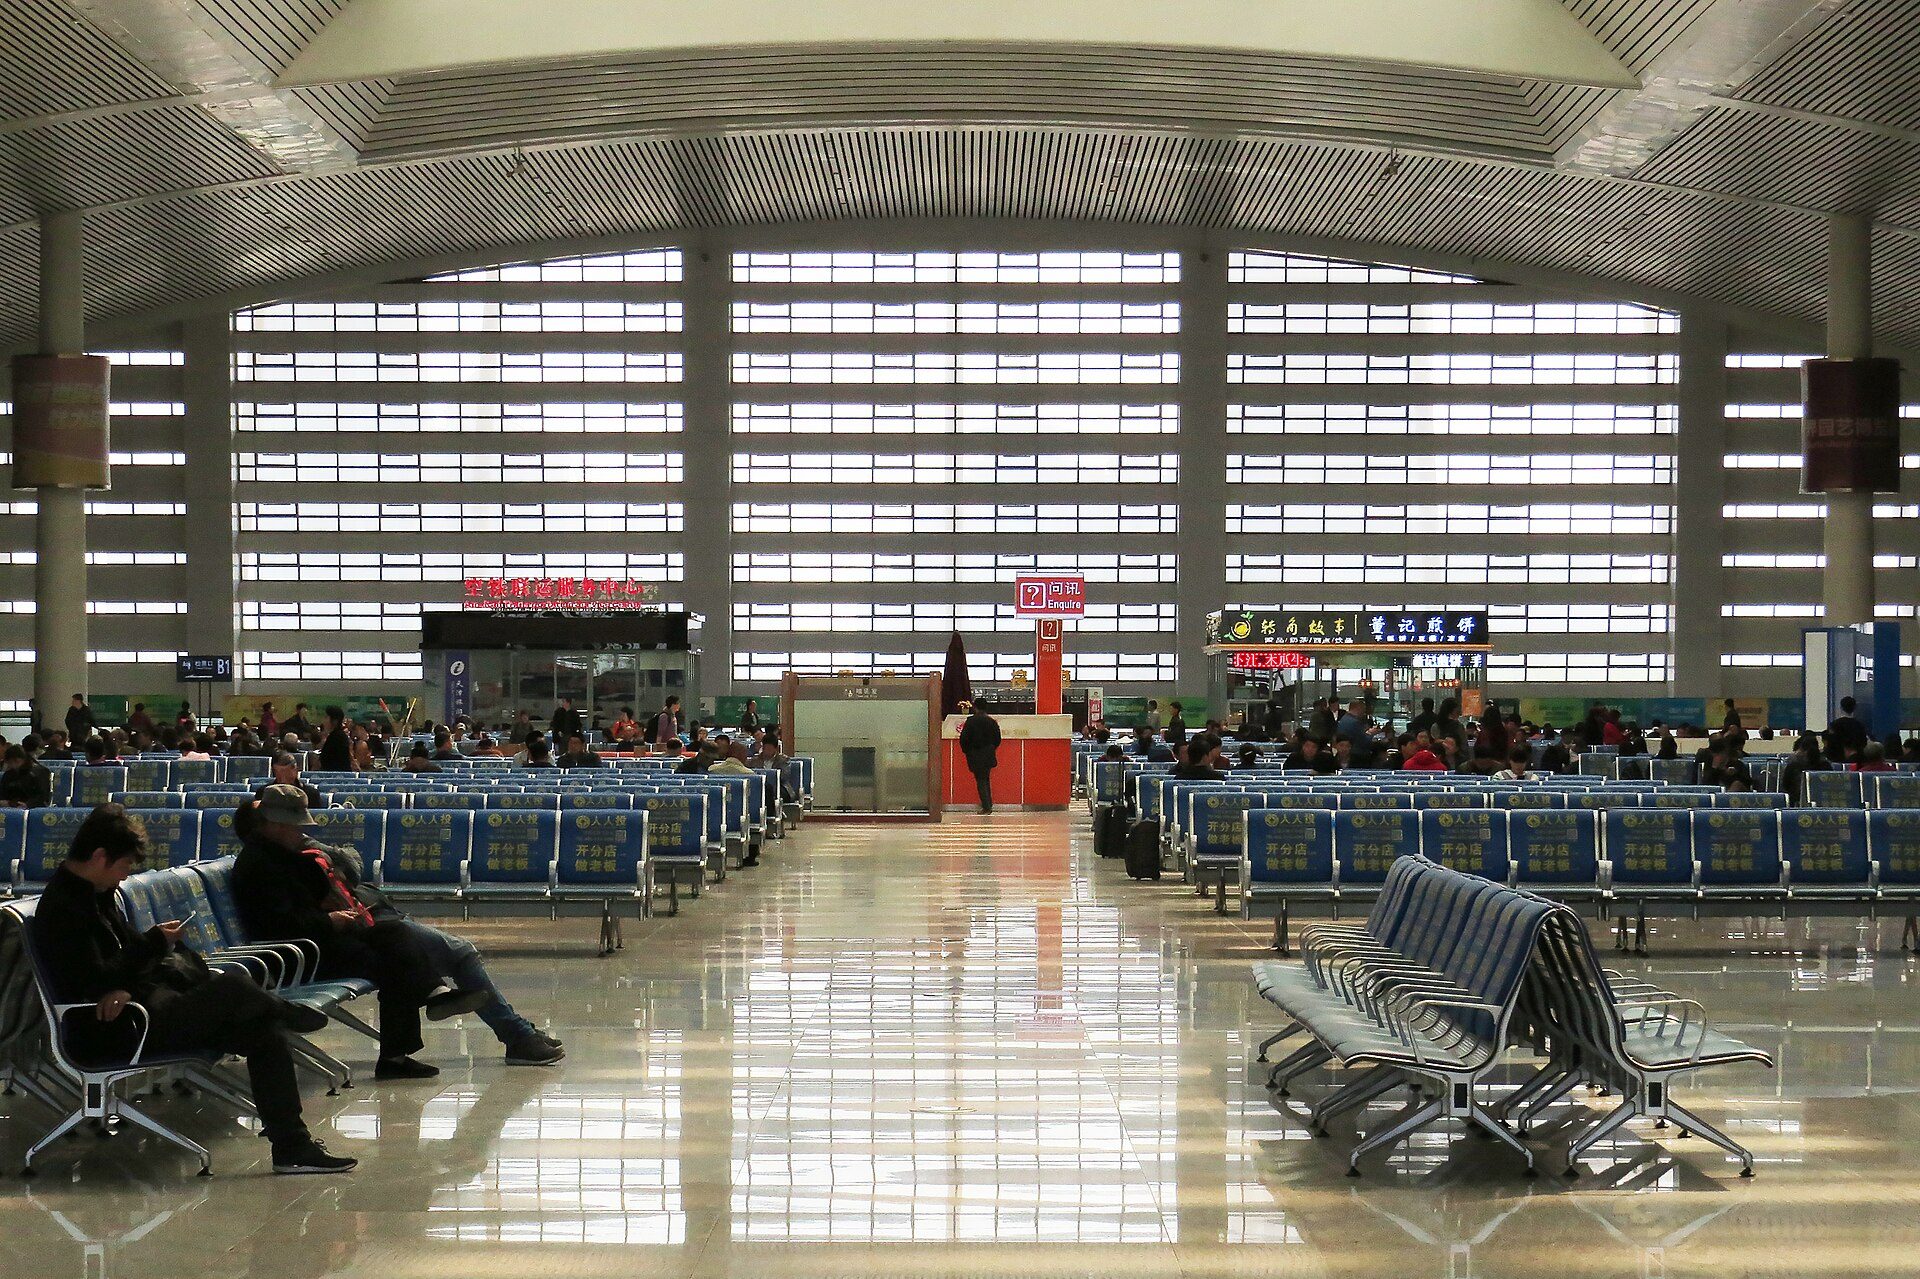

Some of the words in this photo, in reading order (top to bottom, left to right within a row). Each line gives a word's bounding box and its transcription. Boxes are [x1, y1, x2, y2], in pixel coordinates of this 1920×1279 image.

[1049, 582, 1081, 595] 问讯
[1048, 600, 1081, 611] Enquire
[1261, 617, 1345, 635] 转角故事
[1369, 616, 1475, 634] 董记煎饼
[217, 658, 230, 674] B1
[402, 843, 441, 856] 开分店
[488, 843, 528, 856] 开分店
[576, 844, 617, 857] 开分店
[1266, 843, 1308, 856] 开分店
[1353, 843, 1394, 856] 开分店
[1441, 843, 1482, 856] 开分店
[1528, 843, 1569, 856] 开分店
[1625, 843, 1666, 856] 开分店
[1711, 843, 1753, 856] 开分店
[1800, 843, 1842, 856] 开分店
